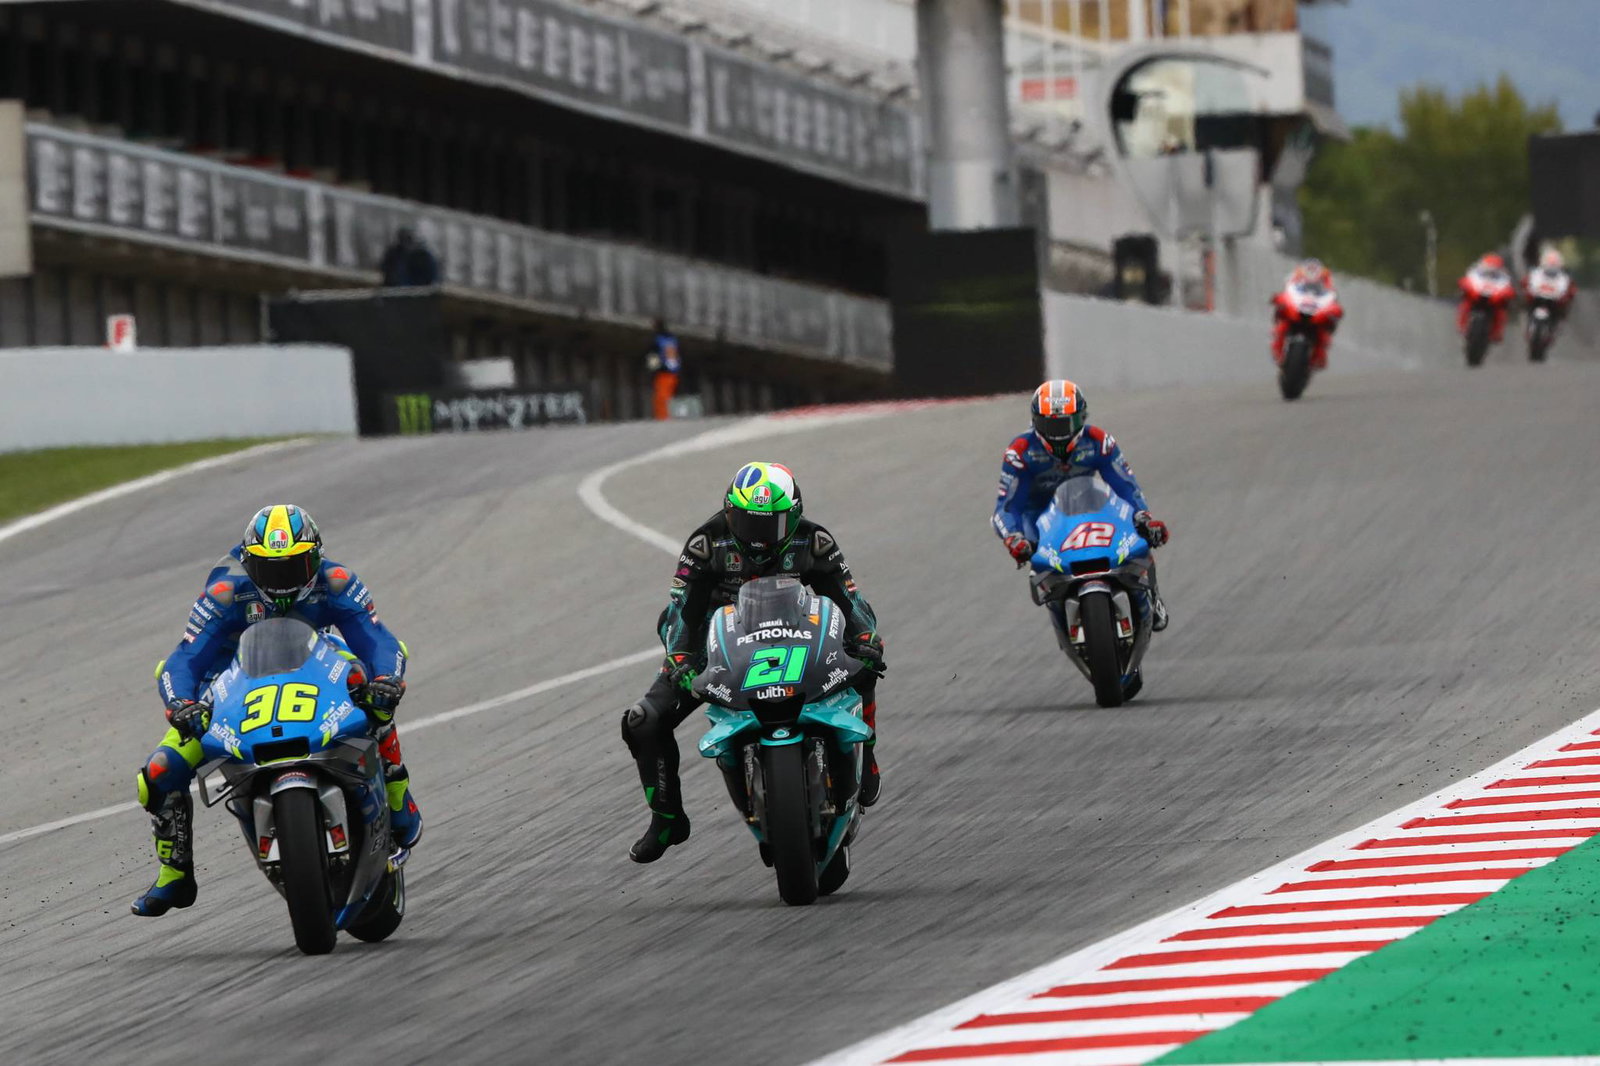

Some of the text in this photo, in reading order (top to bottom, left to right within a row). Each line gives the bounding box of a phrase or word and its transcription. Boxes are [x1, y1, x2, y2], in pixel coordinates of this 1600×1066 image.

[1060, 521, 1115, 552] 42
[736, 628, 813, 647] PETRONAS
[740, 644, 811, 691] 21
[240, 683, 320, 734] 36
[756, 685, 794, 701] withu
[319, 700, 350, 732] SUZUKI
[211, 722, 242, 748] SUZUKI
